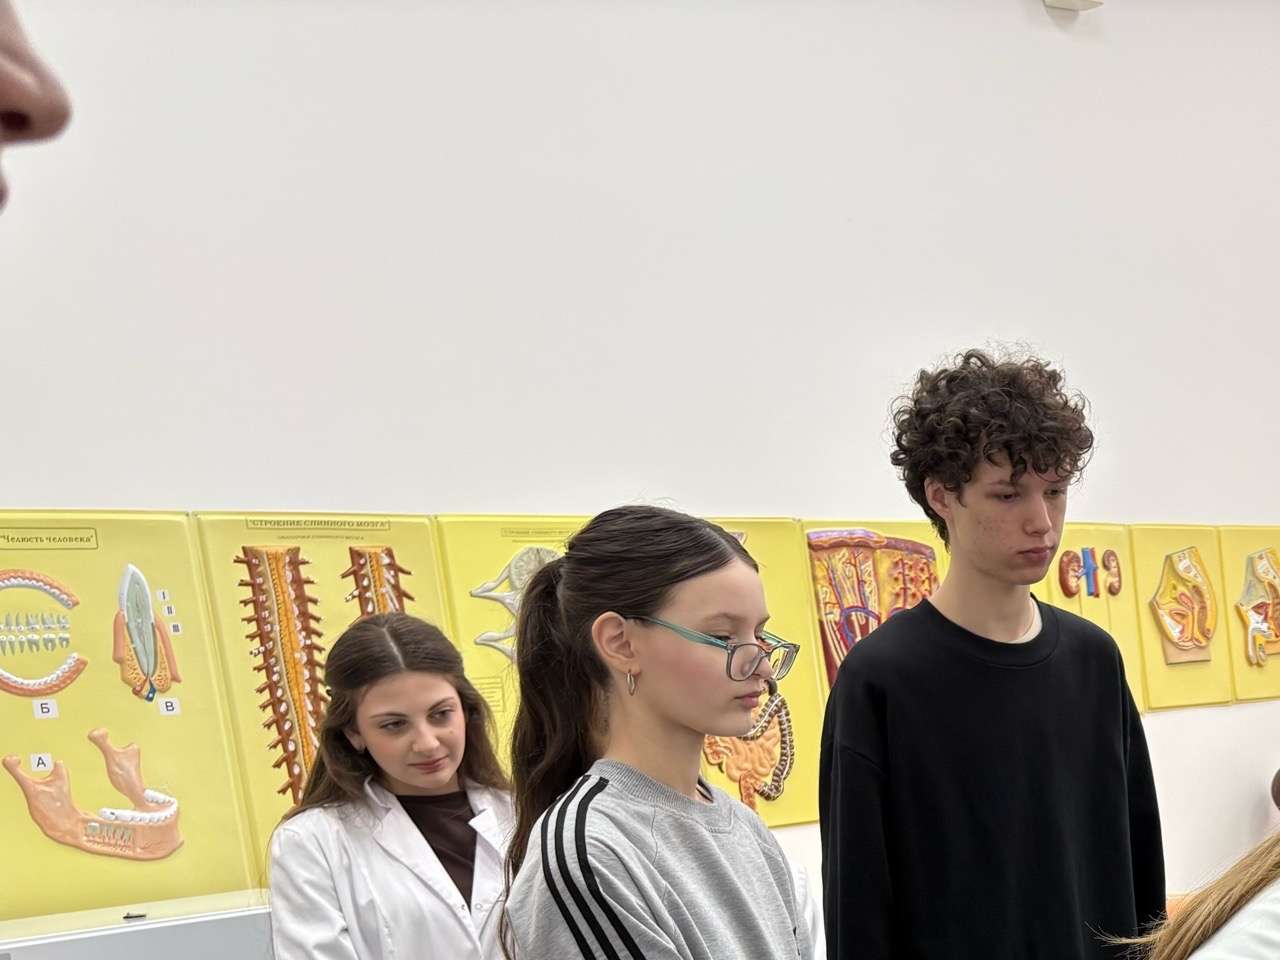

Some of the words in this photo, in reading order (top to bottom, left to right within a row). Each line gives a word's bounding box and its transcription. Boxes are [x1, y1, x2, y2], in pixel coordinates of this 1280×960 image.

[40, 702, 50, 714] Б
[165, 701, 175, 712] В
[36, 756, 47, 768] А
